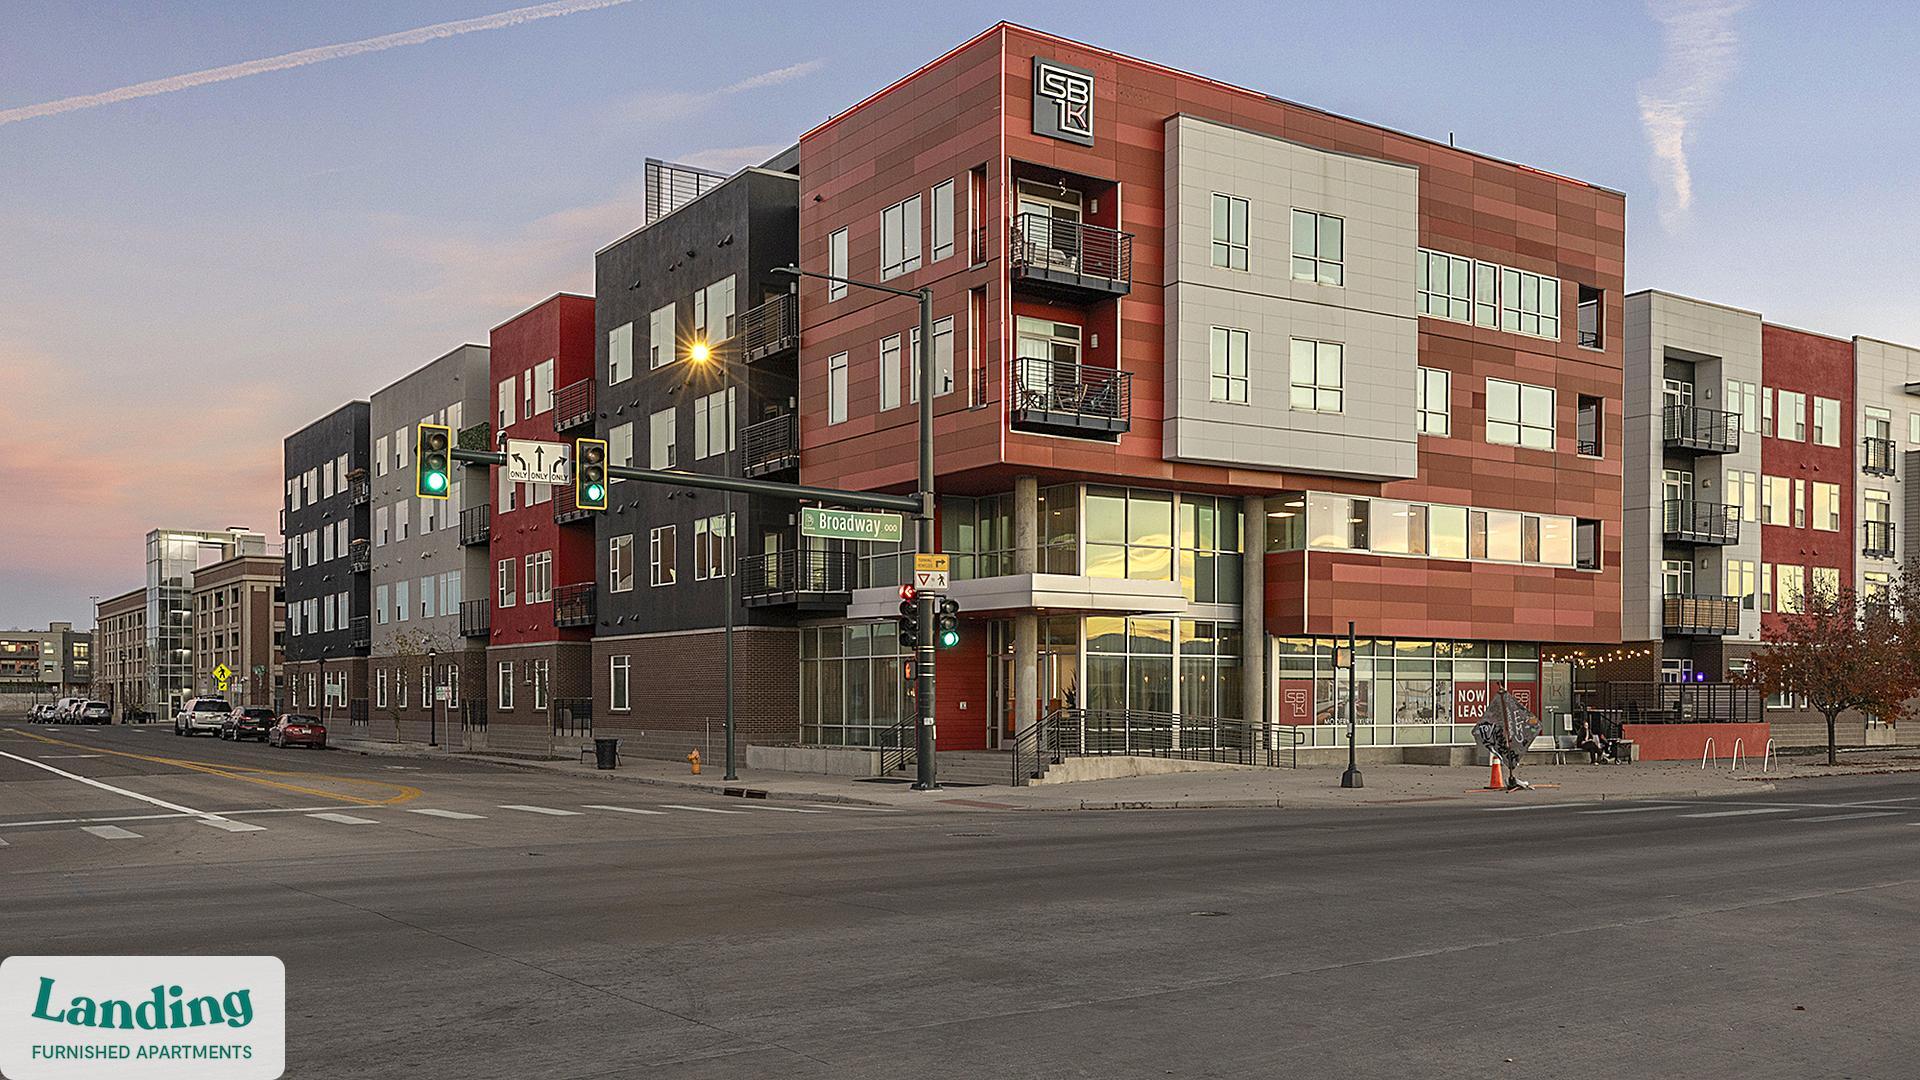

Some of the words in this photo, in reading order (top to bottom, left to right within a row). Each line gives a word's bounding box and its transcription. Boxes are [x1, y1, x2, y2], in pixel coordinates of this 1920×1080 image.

[510, 471, 528, 479] ONLY
[531, 472, 548, 480] ONLY
[819, 512, 881, 538] Broadway
[1458, 689, 1486, 702] NOW
